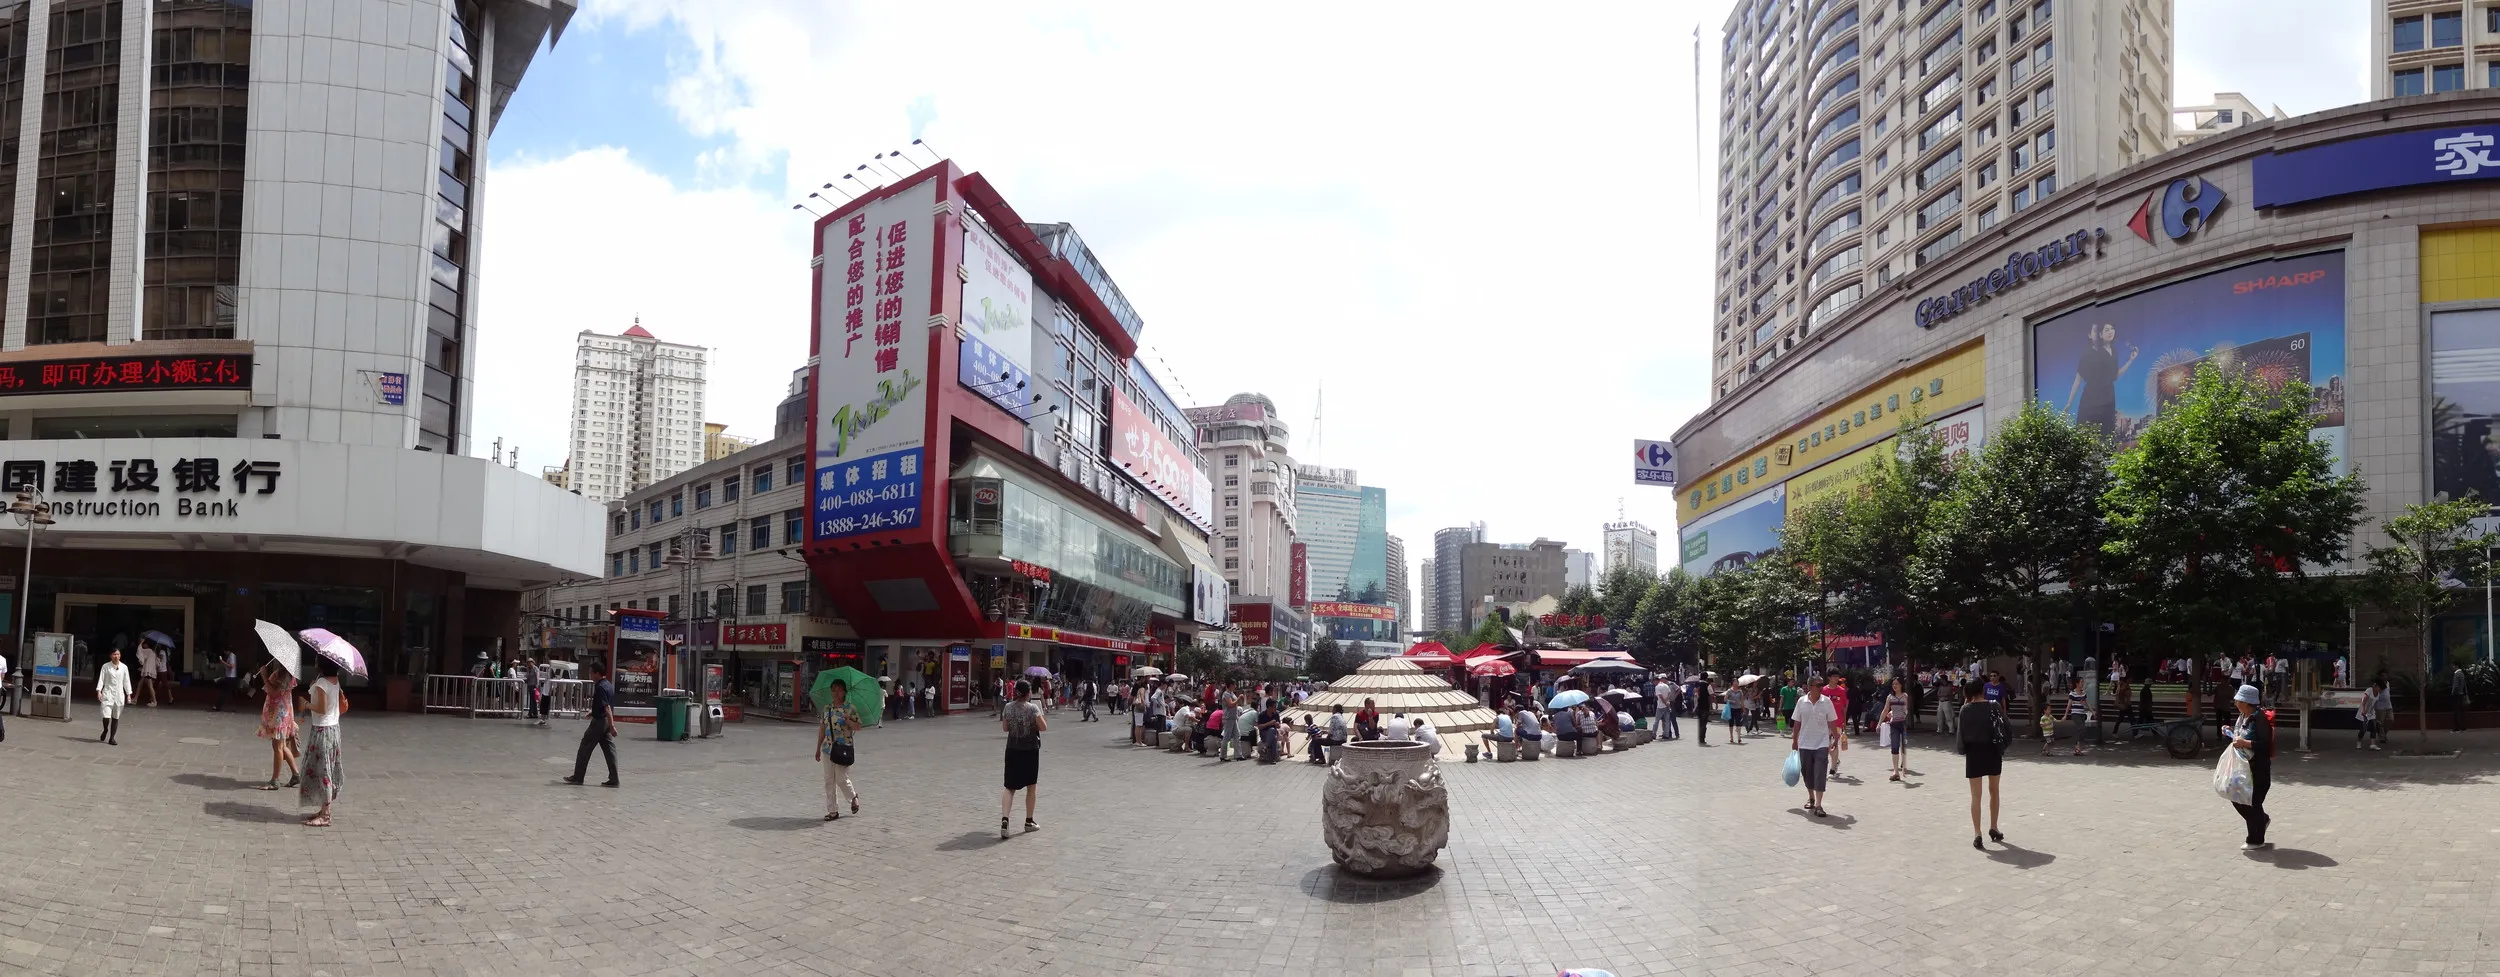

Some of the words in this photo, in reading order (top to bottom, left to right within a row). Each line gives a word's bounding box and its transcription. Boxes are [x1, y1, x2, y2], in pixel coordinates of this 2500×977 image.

[2434, 132, 2500, 176] 家
[844, 212, 866, 359] 配合您的推广
[1914, 224, 2089, 329] Carrefour
[2290, 337, 2306, 351] 60
[1, 457, 281, 495] 国建设银行
[820, 454, 917, 491] 媒体招租
[1637, 469, 1674, 482] 家乐福
[178, 498, 239, 517] Bank
[819, 481, 916, 512] 400-088-6811
[819, 507, 916, 536] 13888-246-367
